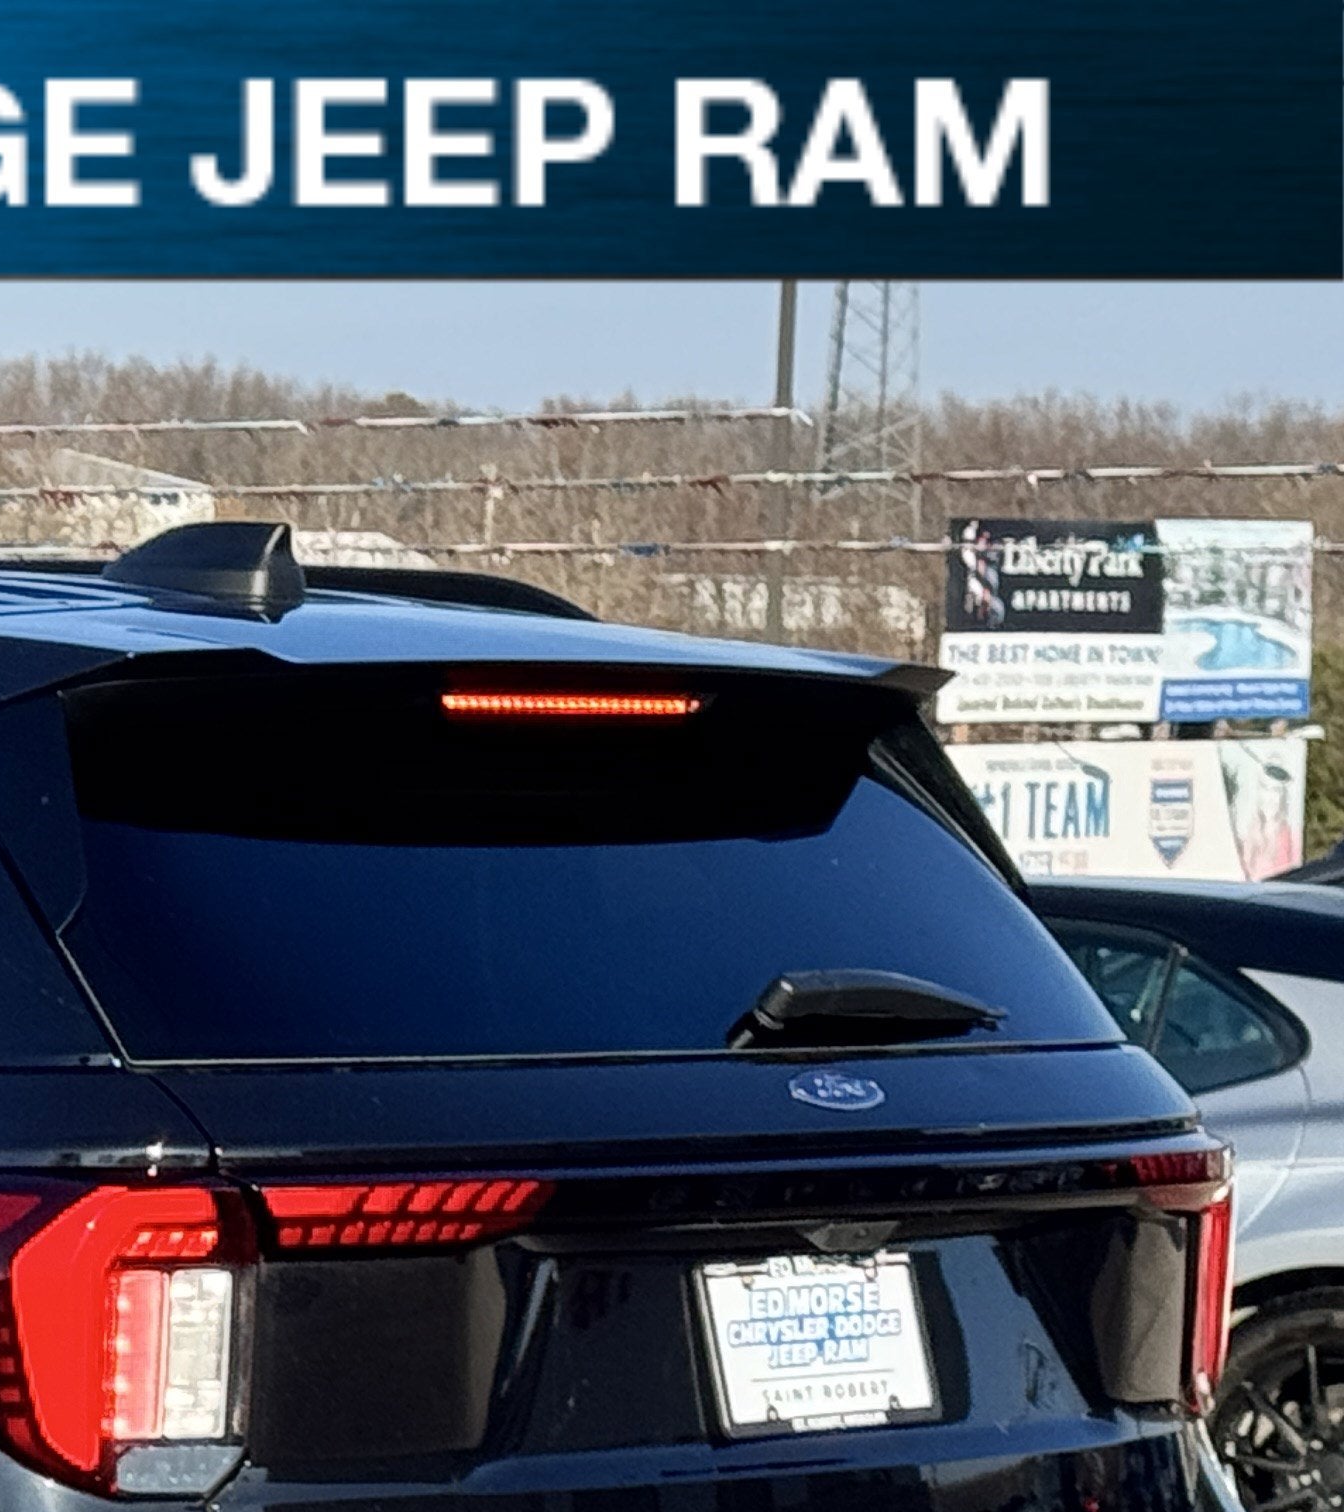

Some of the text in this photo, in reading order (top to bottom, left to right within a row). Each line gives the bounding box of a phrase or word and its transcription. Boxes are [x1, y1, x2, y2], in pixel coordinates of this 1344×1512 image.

[1086, 540, 1145, 579] Park
[948, 643, 982, 666] THE
[987, 643, 1030, 666] BEST
[1025, 780, 1111, 839] TEAM
[750, 1282, 880, 1319] ED MORSE
[727, 1310, 902, 1347] CHRYSLER DODGE
[768, 1338, 870, 1368] JEEP RAM
[762, 1379, 890, 1403] SAINT ROBERT
